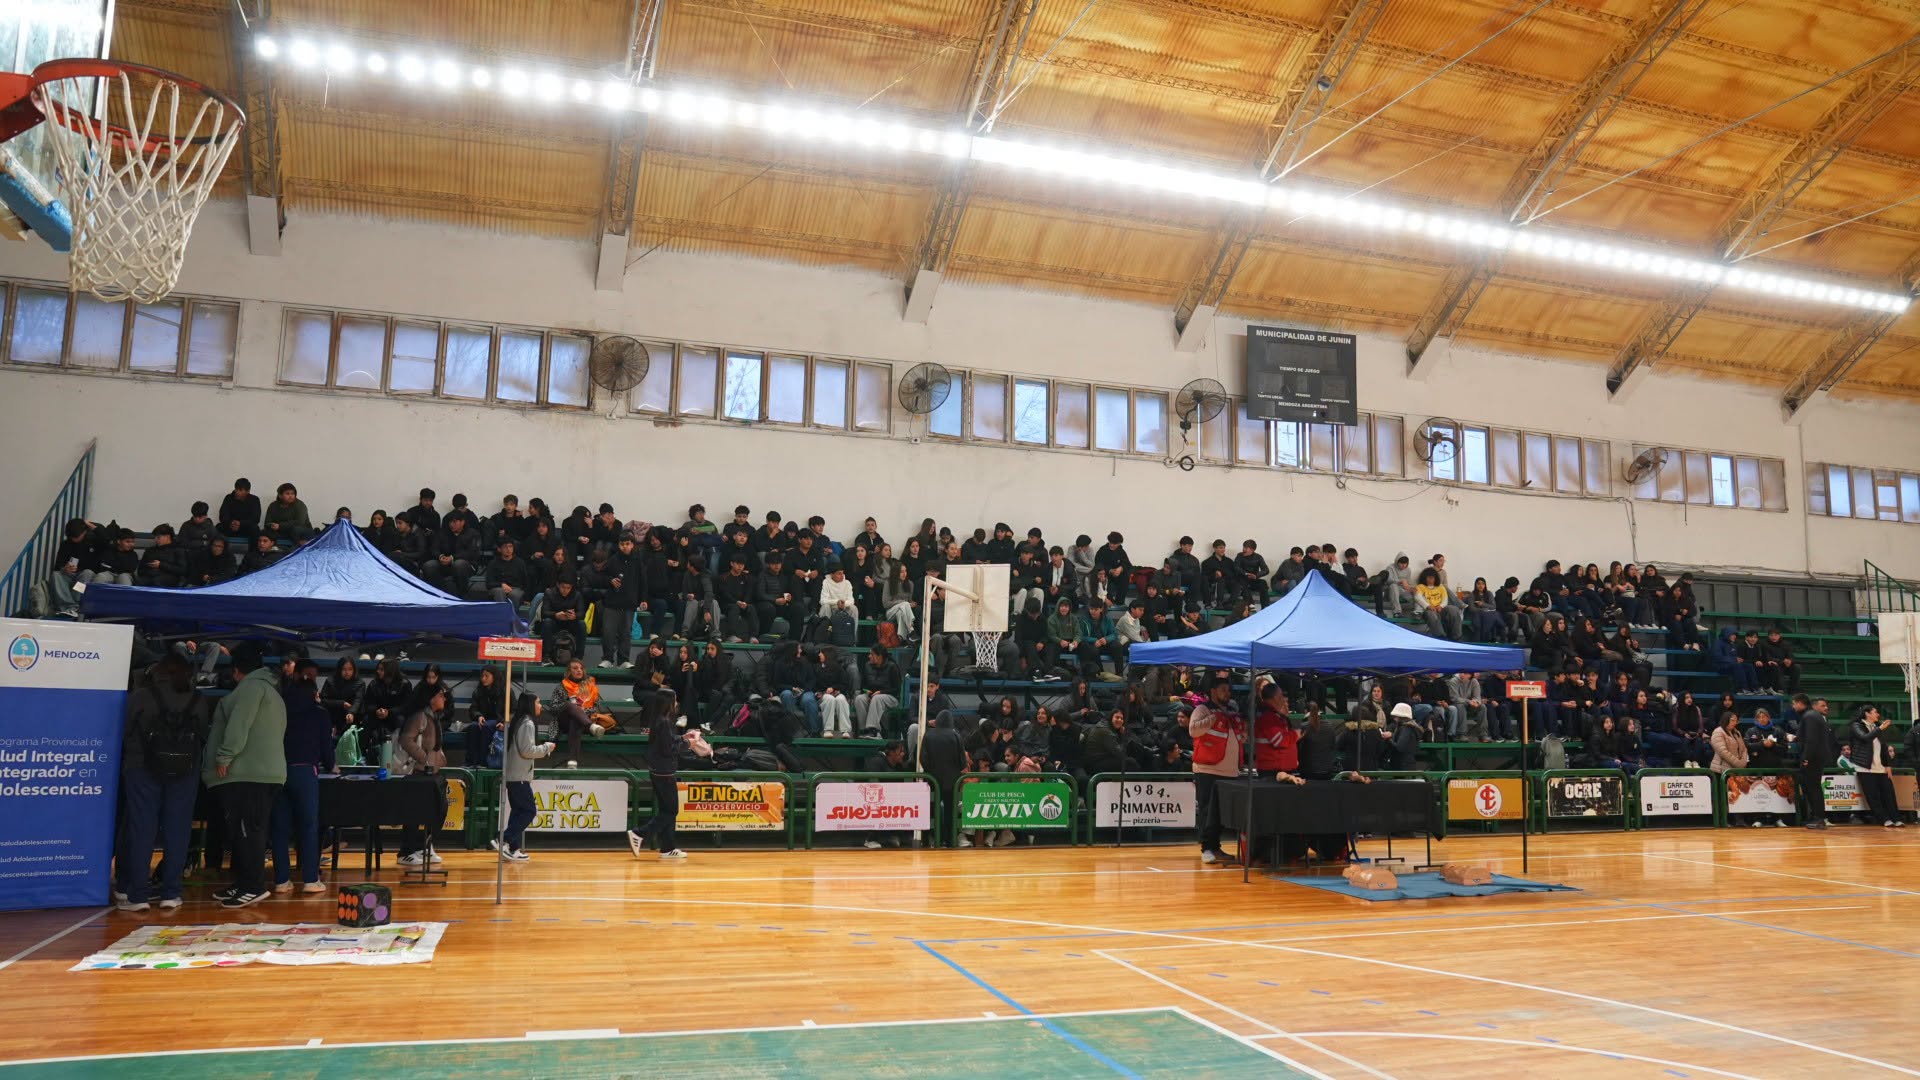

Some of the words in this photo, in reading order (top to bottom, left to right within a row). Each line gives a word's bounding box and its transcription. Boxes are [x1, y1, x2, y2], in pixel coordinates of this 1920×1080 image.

[1256, 329, 1315, 341] MUNICIPALIDAD
[1329, 336, 1351, 344] JUNIN
[44, 650, 100, 660] MENDOZA
[41, 737, 89, 746] Provincial
[91, 737, 103, 746] de
[0, 749, 27, 763] lud
[31, 750, 95, 765] Integral
[98, 753, 108, 763] e
[79, 768, 97, 778] en
[688, 785, 764, 803] DENGRA
[1564, 782, 1602, 799] OCRE
[533, 791, 601, 812] ARCA
[1110, 803, 1182, 814] PRIMAVERA
[966, 803, 1037, 819] JUNIN
[559, 813, 601, 829] NOE
[1132, 817, 1161, 825] pizzeria
[0, 839, 71, 847] saludadolescentemza
